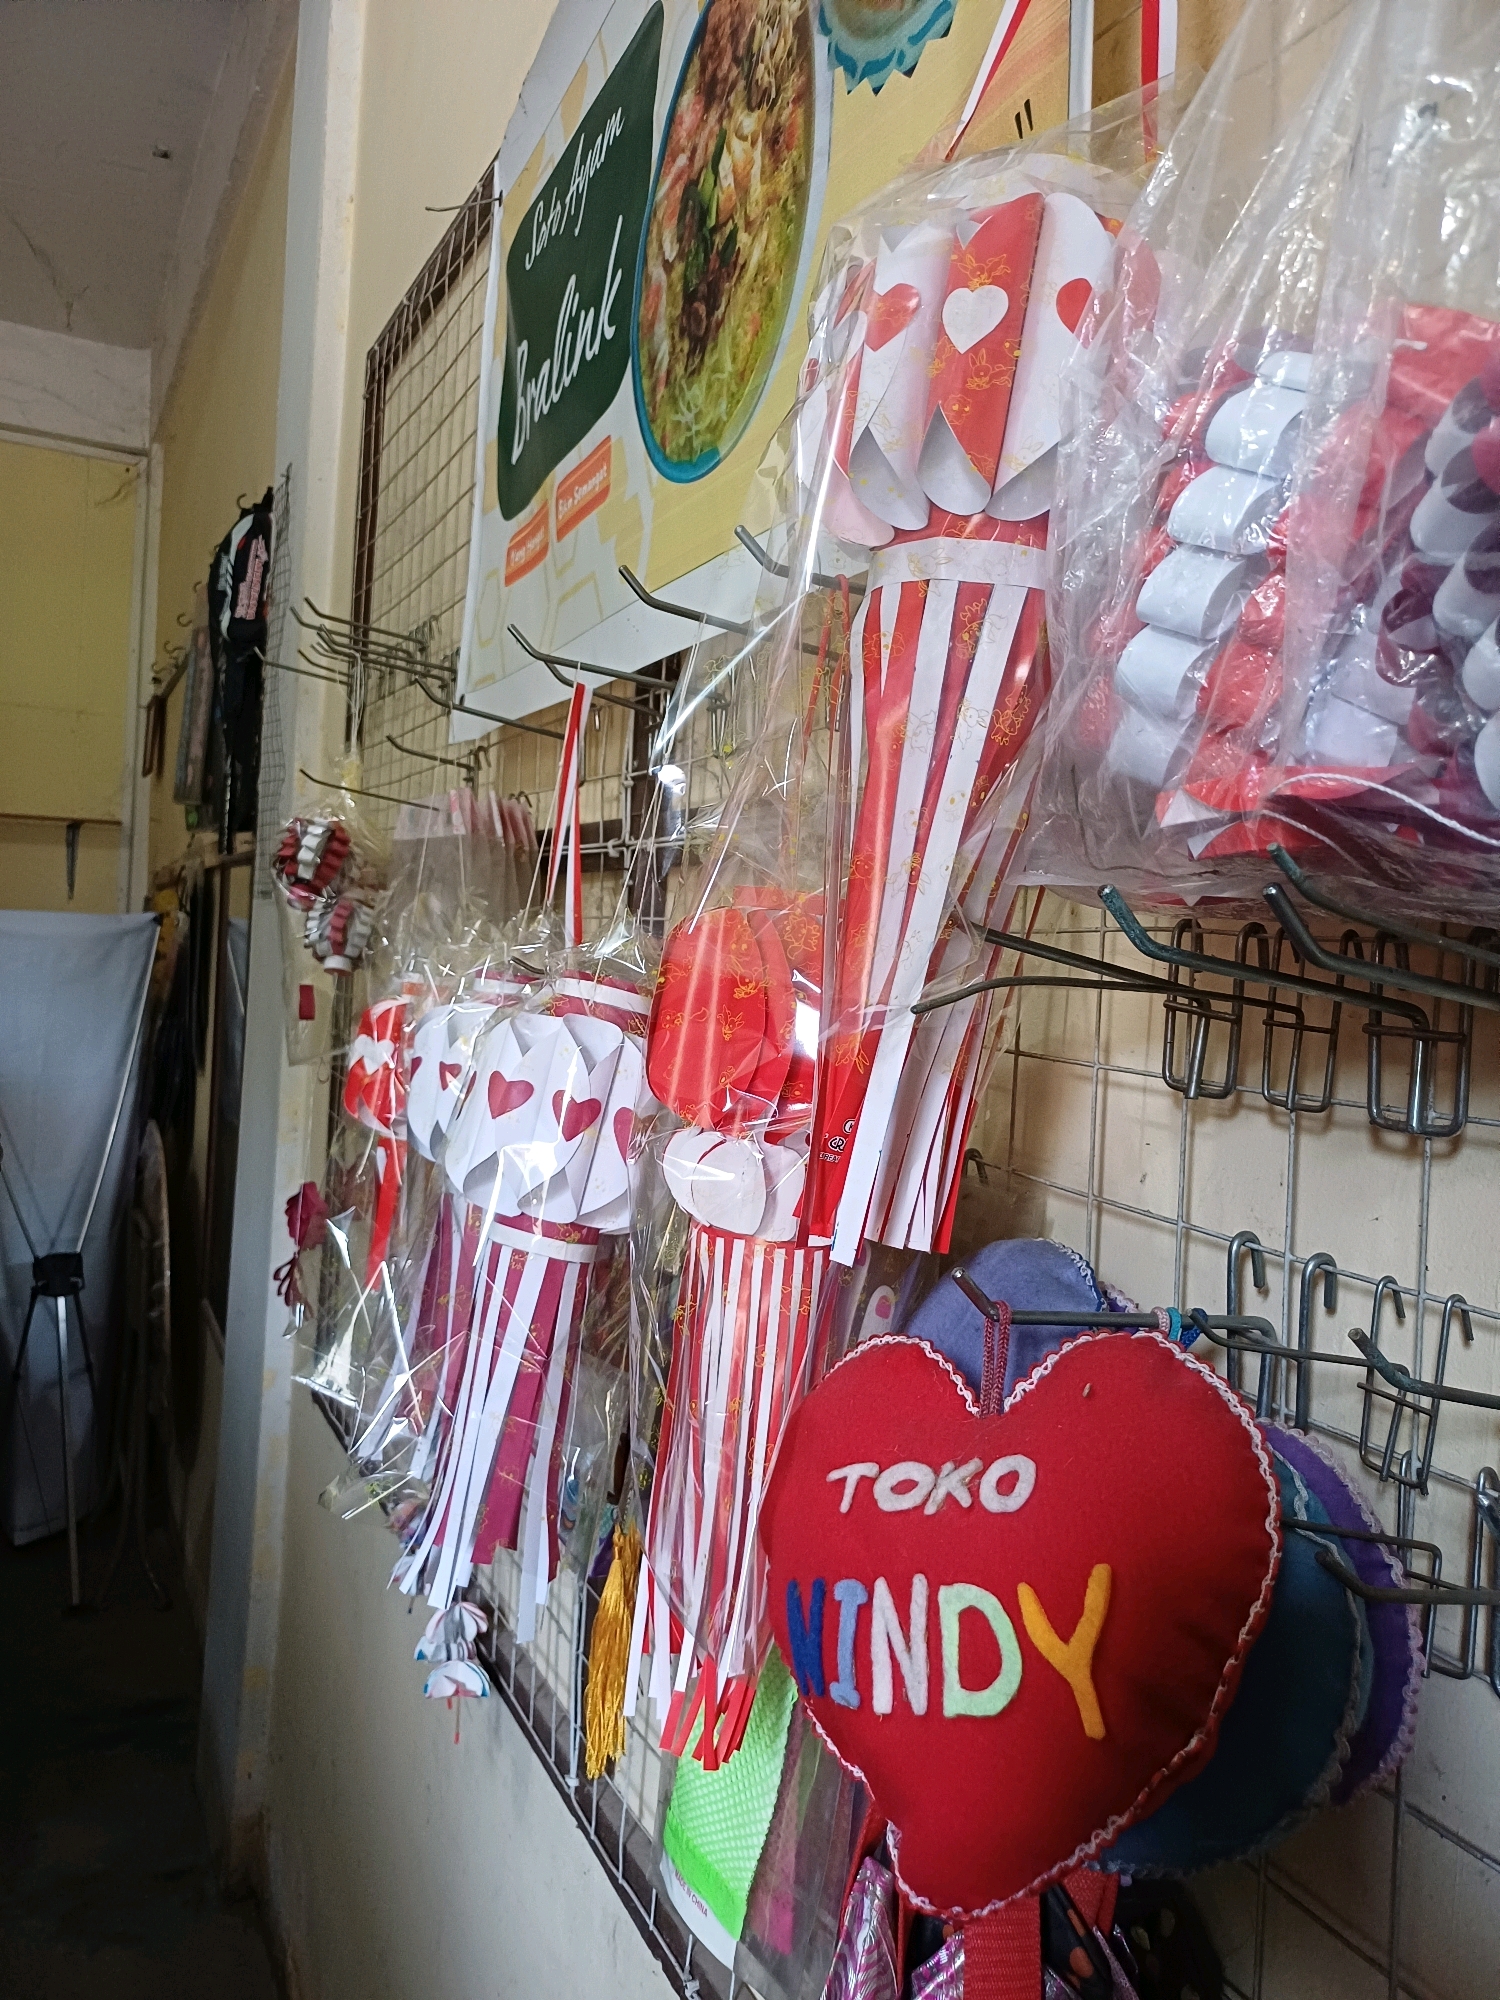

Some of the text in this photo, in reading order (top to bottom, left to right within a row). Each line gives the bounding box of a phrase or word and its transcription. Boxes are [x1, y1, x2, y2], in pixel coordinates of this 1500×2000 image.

[560, 107, 625, 237] Ayam
[511, 215, 622, 465] Bralink
[826, 1454, 1037, 1516] TOKO
[692, 1894, 708, 1917] CHINA
